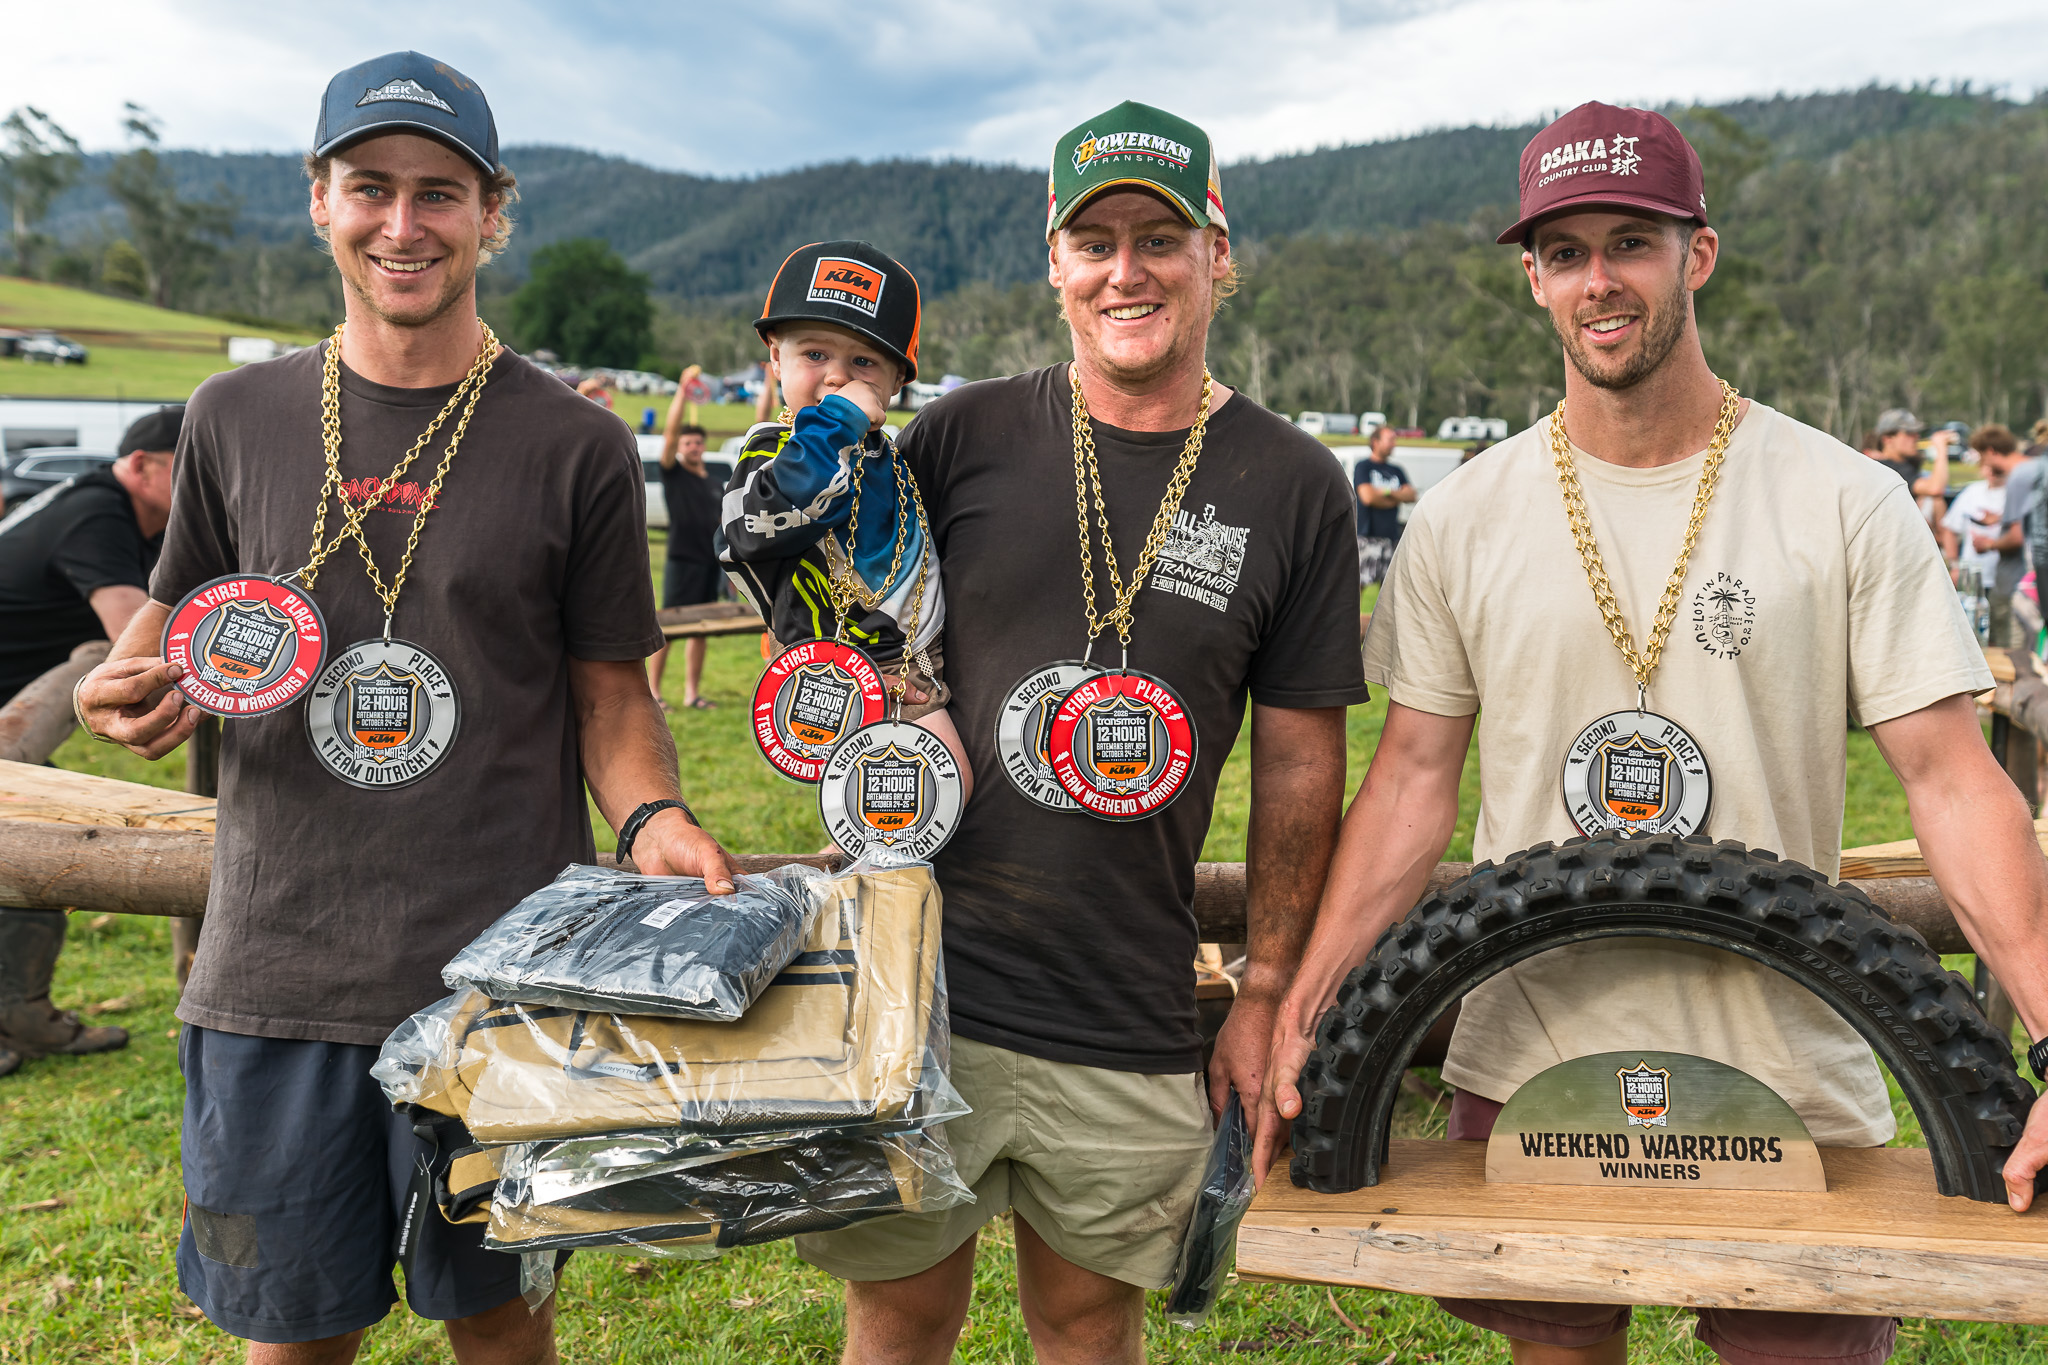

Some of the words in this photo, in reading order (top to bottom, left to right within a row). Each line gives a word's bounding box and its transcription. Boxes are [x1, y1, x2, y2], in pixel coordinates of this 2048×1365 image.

[380, 93, 446, 110] EXCAVATIONS
[1077, 132, 1192, 165] BOWERMAN
[1540, 138, 1607, 174] OSAKA
[1093, 154, 1184, 172] TRANSPORT
[1538, 165, 1578, 188] COUNTRY
[1582, 163, 1607, 173] CLUB
[824, 268, 872, 291] KTM
[812, 289, 846, 300] RACING
[850, 295, 875, 312] TEAM
[1220, 525, 1250, 552] NOISE
[1155, 557, 1238, 594] TRANSMOTO
[1175, 580, 1211, 604] YOUNG
[1210, 596, 1228, 610] 2021
[1692, 593, 1704, 622] LOST
[1702, 579, 1714, 591] IN
[1718, 572, 1756, 624] PARADISE
[204, 582, 247, 605] FIRST
[281, 594, 317, 633] PLACE
[230, 613, 280, 635] transmoto
[223, 622, 276, 649] 12-HOUR
[218, 636, 247, 651] BATEMANS
[258, 647, 270, 657] NSW
[220, 643, 244, 657] OCTOBER
[244, 650, 261, 662] 24-25
[220, 662, 249, 675] KTM
[323, 652, 364, 689] SECOND
[408, 653, 446, 690] PLACE
[780, 644, 815, 672] FIRST
[845, 653, 879, 692] PLACE
[200, 665, 224, 682] RACE
[232, 678, 259, 696] MATES!
[358, 684, 408, 694] transmoto
[803, 678, 847, 696] transmoto
[1018, 671, 1061, 704] SECOND
[180, 674, 234, 711] WEEKEND
[238, 676, 302, 711] WARRIORS
[799, 687, 844, 713] 12-HOUR
[1065, 682, 1101, 716] FIRST
[1135, 680, 1176, 714] PLACE
[358, 696, 408, 711] 12-HOUR
[795, 703, 820, 715] BATEMANS
[384, 719, 402, 727] 24-25
[798, 711, 818, 722] OCTOBER
[818, 717, 834, 726] 24-25
[1096, 716, 1146, 726] transmoto
[367, 734, 396, 743] KTM
[783, 733, 803, 750] RACE
[800, 728, 824, 741] KTM
[1096, 726, 1147, 742] 12-HOUR
[1576, 720, 1617, 756] SECOND
[1660, 725, 1699, 766] PLACE
[354, 743, 374, 760] RACE
[384, 743, 408, 761] MATES!
[757, 714, 776, 747] TEAM
[769, 743, 815, 778] WEEKEND
[834, 733, 873, 771] SECOND
[914, 733, 951, 771] PLACE
[327, 744, 363, 778] TEAM
[365, 747, 434, 782] OUTRIGHT
[868, 766, 915, 776] transmoto
[1109, 765, 1136, 774] KTM
[1610, 754, 1661, 767] transmoto
[867, 777, 915, 792] 12-HOUR
[1011, 761, 1044, 796] TEAM
[1096, 776, 1116, 792] RACE
[1125, 775, 1150, 792] MATES!
[1610, 764, 1661, 784] 12-HOUR
[1058, 763, 1085, 795] TEAM
[1083, 789, 1137, 814] WEEKEND
[1137, 759, 1186, 810] WARRIORS
[1609, 781, 1636, 790] BATEMANS
[1648, 785, 1660, 793] NSW
[1614, 788, 1636, 797] OCTOBER
[1636, 791, 1654, 800] 24-25
[877, 816, 903, 825] KTM
[1620, 805, 1647, 816] KTM
[1580, 812, 1605, 835] TEA
[1606, 813, 1626, 829] RACE
[1635, 818, 1661, 834] MATES!
[838, 826, 865, 857] TEA
[896, 829, 939, 857] RIGHT
[864, 826, 884, 842] RACE
[892, 826, 916, 843] MATES!
[1793, 950, 1940, 1073] DUNLOP
[1626, 1083, 1663, 1094] 12-HOUR
[1520, 1132, 1630, 1159] WEEKEND
[1640, 1134, 1782, 1163] WARRIORS
[1599, 1161, 1700, 1180] WINNERS
